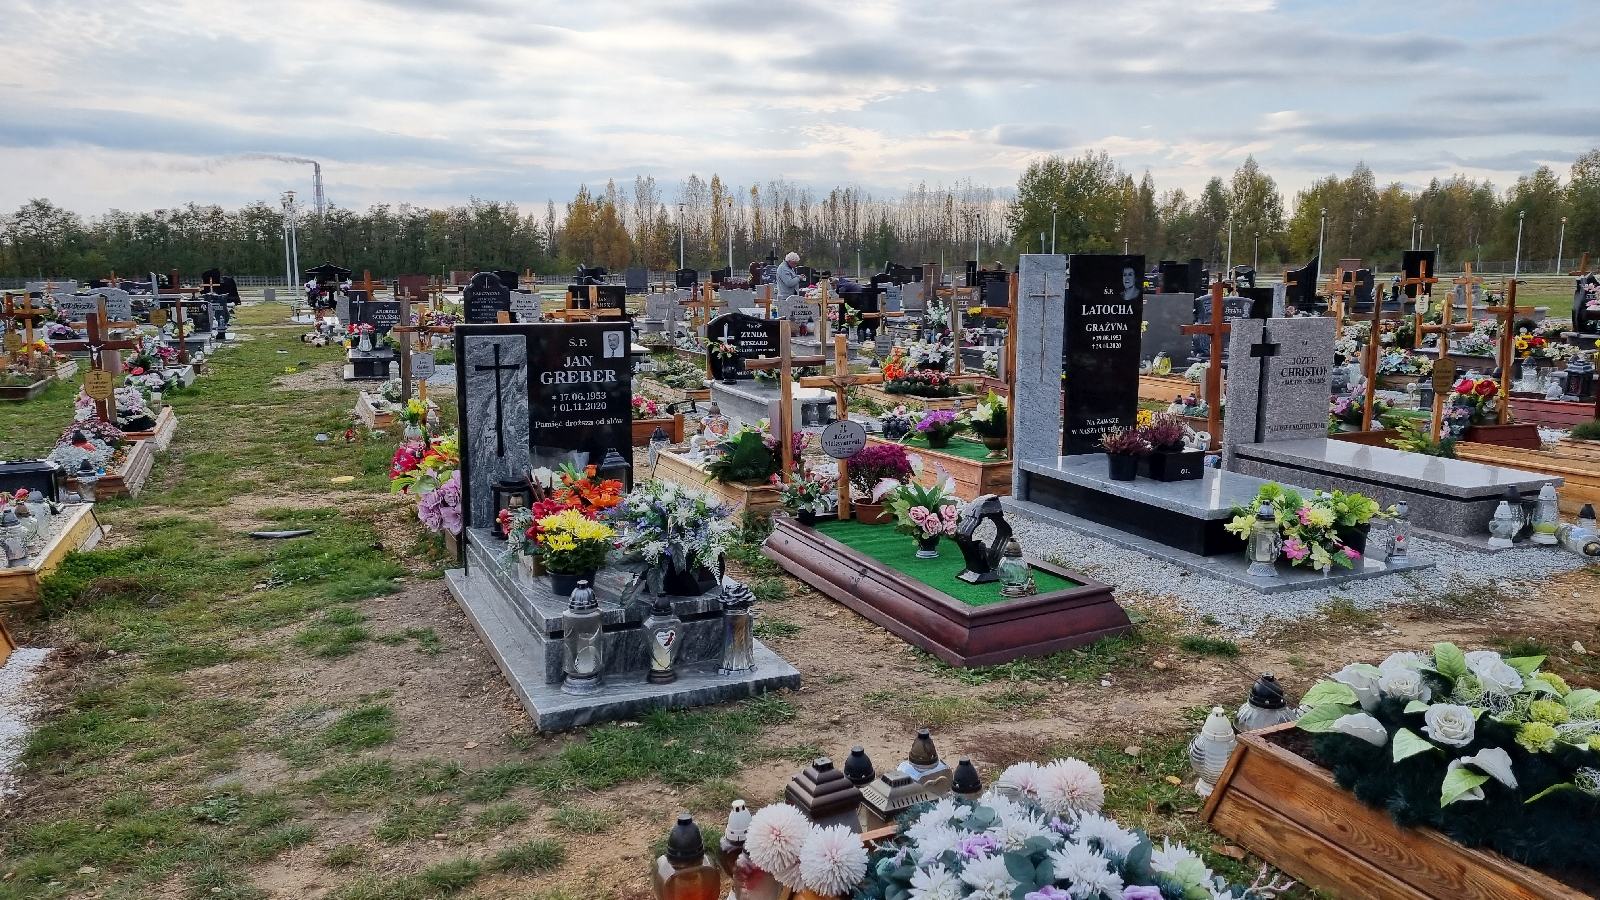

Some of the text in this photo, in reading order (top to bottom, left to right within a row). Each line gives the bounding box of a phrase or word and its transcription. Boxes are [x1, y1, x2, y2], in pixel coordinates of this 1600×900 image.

[1081, 304, 1134, 316] LATOCHA
[1085, 322, 1128, 332] GRAŻYNA
[563, 355, 594, 367] JAN
[540, 369, 617, 385] GREBER
[559, 391, 607, 402] 17.06.1953
[559, 402, 607, 412] 01.11.2020
[535, 420, 563, 429] Pamięć
[565, 419, 594, 427] droższa
